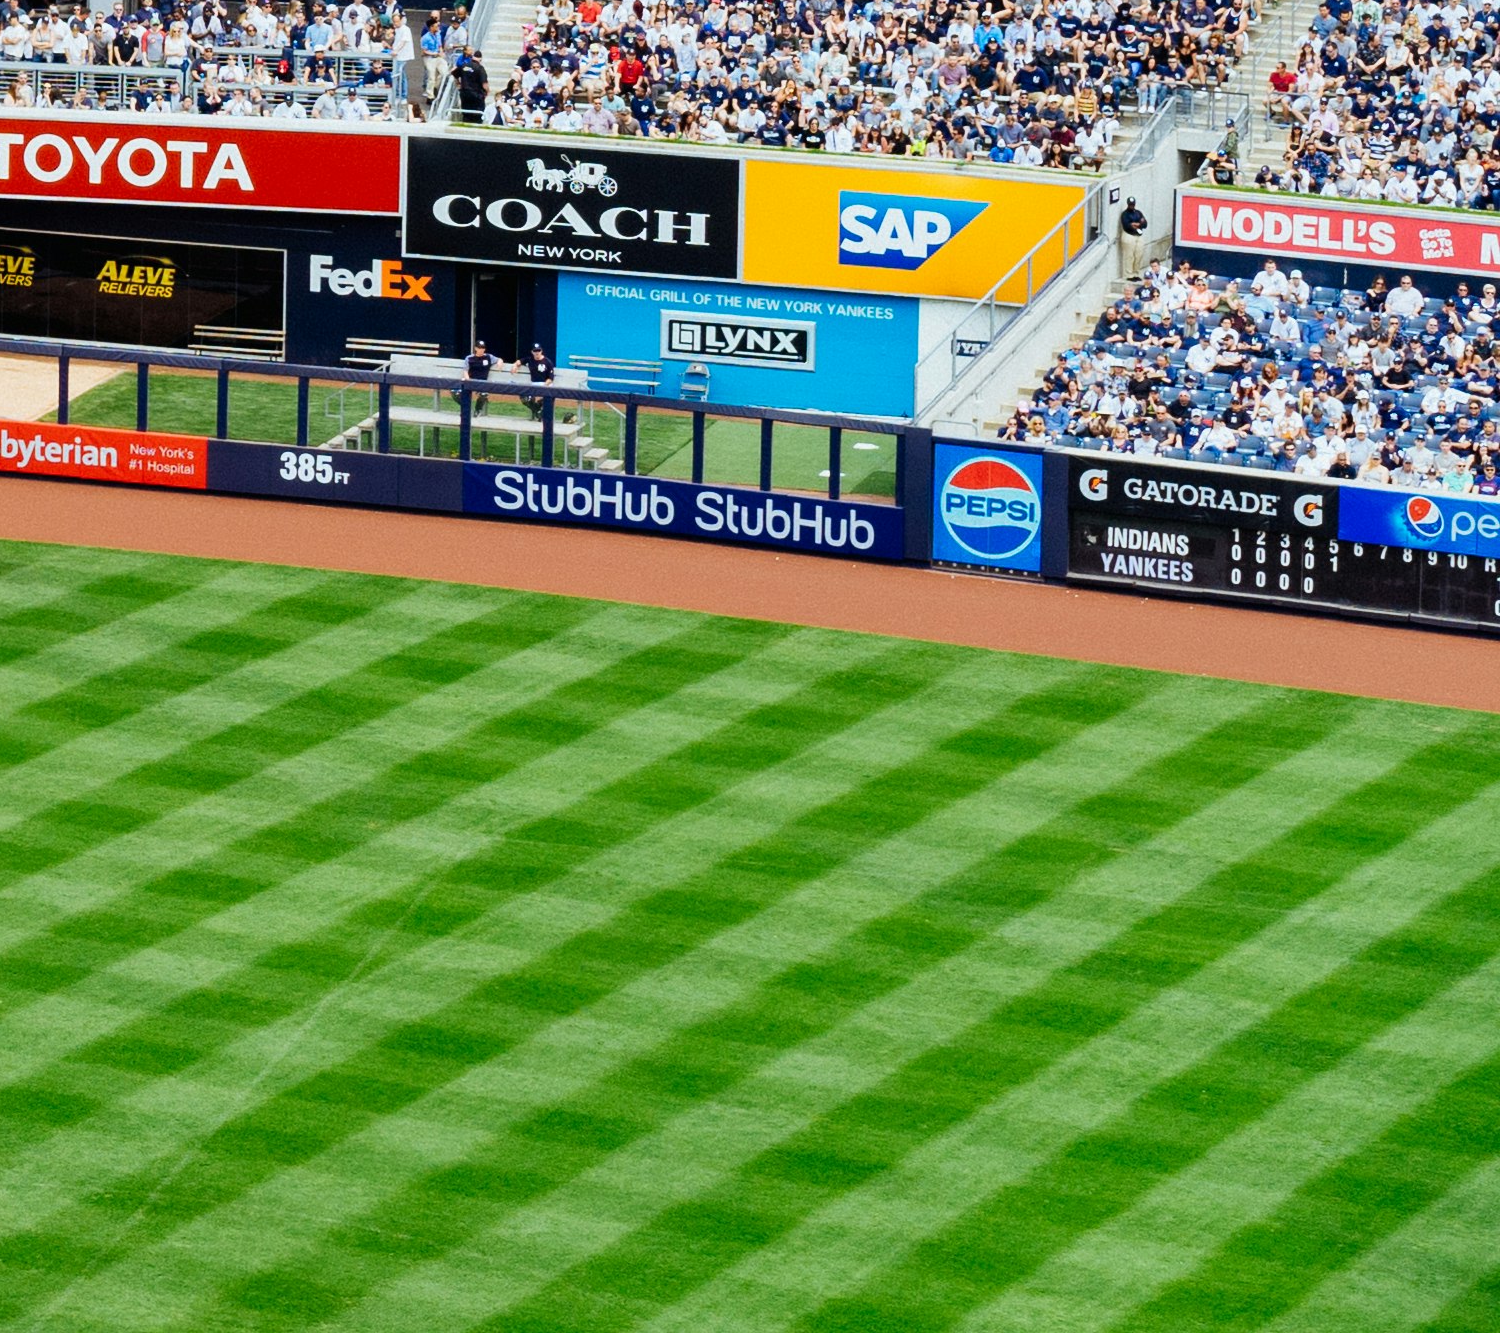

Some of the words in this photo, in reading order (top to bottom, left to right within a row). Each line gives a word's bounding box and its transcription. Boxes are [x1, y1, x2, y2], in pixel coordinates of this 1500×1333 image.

[432, 194, 710, 245] COACH
[839, 205, 951, 257] SAP
[1198, 205, 1396, 255] MODELL'S
[518, 244, 558, 258] NEW
[564, 248, 621, 264] YORK
[309, 254, 432, 301] FedEx
[586, 284, 645, 301] OFFICIAL
[649, 289, 686, 303] GRILL
[692, 292, 710, 305] OF
[716, 294, 740, 307] THE
[746, 297, 775, 310] NEW
[779, 301, 821, 314] YORK
[826, 304, 894, 319] YANKEES
[705, 324, 800, 355] LYNX
[494, 471, 674, 525] StubHub
[695, 492, 874, 551] StubHub
[945, 491, 1038, 523] PEPSI
[1124, 478, 1277, 516] GATORADE
